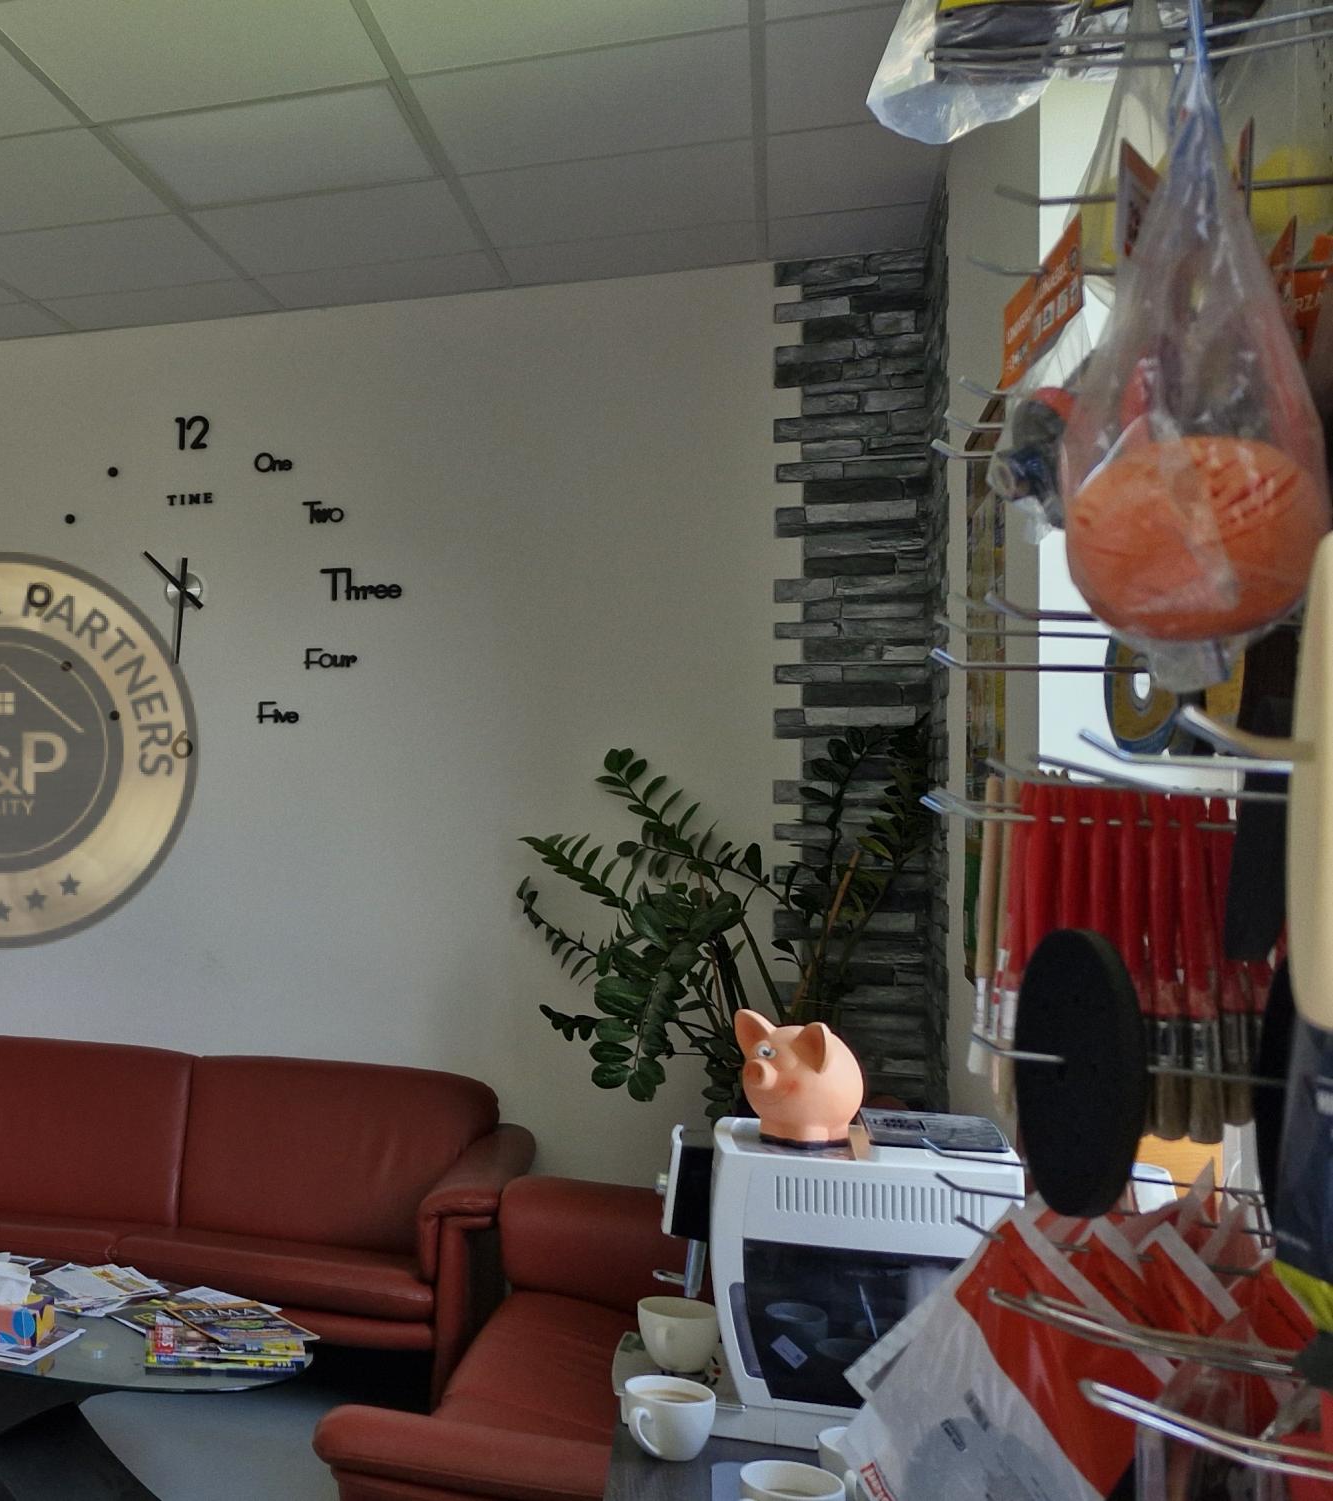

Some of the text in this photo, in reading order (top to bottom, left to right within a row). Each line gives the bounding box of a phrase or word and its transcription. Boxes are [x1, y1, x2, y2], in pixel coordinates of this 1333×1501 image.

[175, 415, 210, 451] 12
[254, 452, 292, 473] One
[167, 492, 213, 506] TIME
[302, 501, 344, 524] Two
[320, 568, 402, 600] Three
[303, 648, 357, 669] Four
[256, 701, 299, 724] Five
[171, 730, 193, 759] 6
